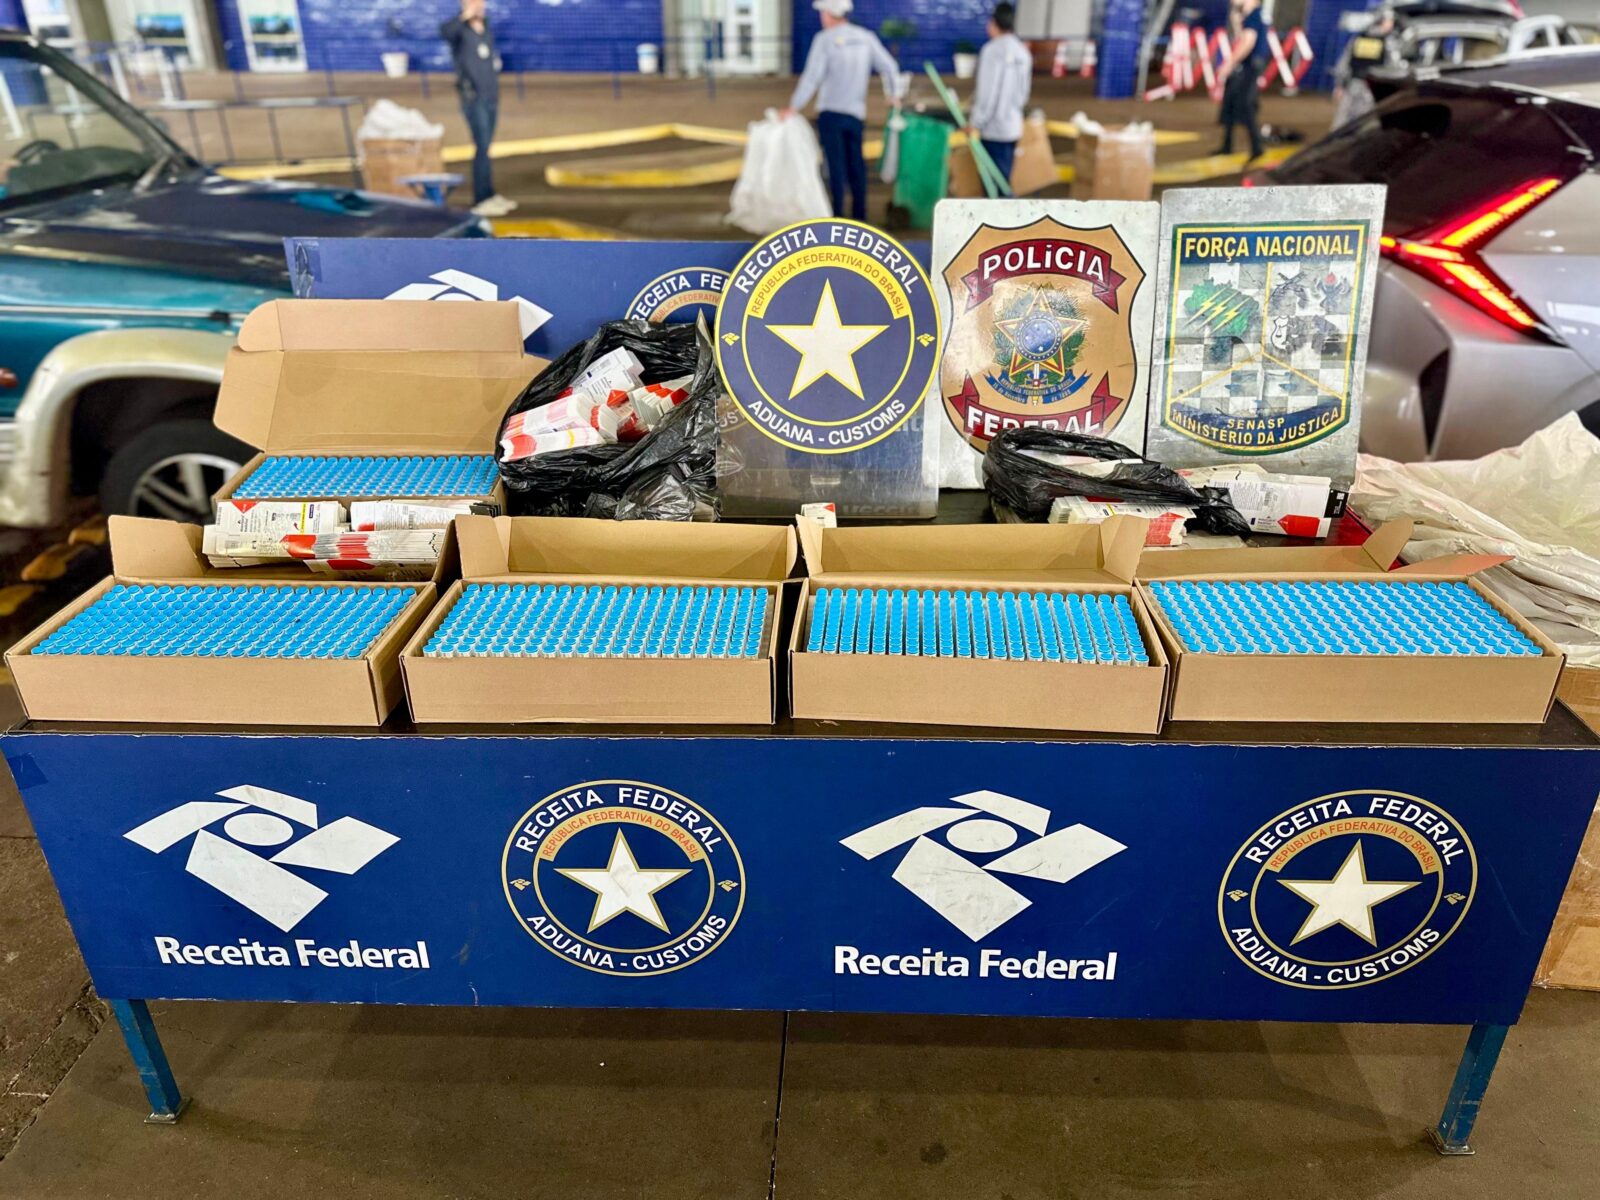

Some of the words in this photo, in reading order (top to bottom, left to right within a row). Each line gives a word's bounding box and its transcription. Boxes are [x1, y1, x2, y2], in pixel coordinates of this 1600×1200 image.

[734, 227, 819, 293] RECEITA
[830, 225, 919, 294] FEDERAL
[1185, 236, 1249, 263] FORÇA
[1255, 235, 1354, 257] NACIONAL
[751, 262, 797, 314] REPÚBLICA
[796, 252, 863, 270] FEDERATIVA
[864, 263, 881, 279] DO
[879, 271, 903, 315] BRASIL
[748, 400, 814, 444] ADUANA
[828, 399, 906, 445] CUSTOMS
[967, 405, 1101, 437] FEAL
[1171, 409, 1252, 445] MINISTÉRIO
[1257, 431, 1275, 445] DA
[1279, 407, 1340, 442] JUSTIÇA
[1227, 417, 1285, 430] SENASP
[515, 789, 604, 853] RECEITA
[618, 787, 722, 854] FEDERAL
[542, 815, 587, 858] REPÚBLICA
[586, 810, 653, 825] FEDERATIVA
[655, 818, 671, 833] DO
[669, 828, 700, 859] BRASIL
[1245, 799, 1353, 864] RECEITA
[1368, 797, 1465, 866] FEDERAL
[1270, 826, 1327, 868] REPÚBLICA
[1328, 821, 1398, 836] FEDERATIVA
[1398, 829, 1413, 844] DO
[1411, 838, 1438, 870] BRASIL
[154, 936, 291, 967] Receita
[294, 938, 430, 969] Federal
[527, 916, 614, 969] ADUANA
[632, 914, 727, 970] CUSTOMS
[834, 945, 970, 977] Receita
[979, 948, 1118, 981] Federal
[1231, 926, 1307, 982] ADUANA
[1326, 928, 1440, 984] CUSTOMS
